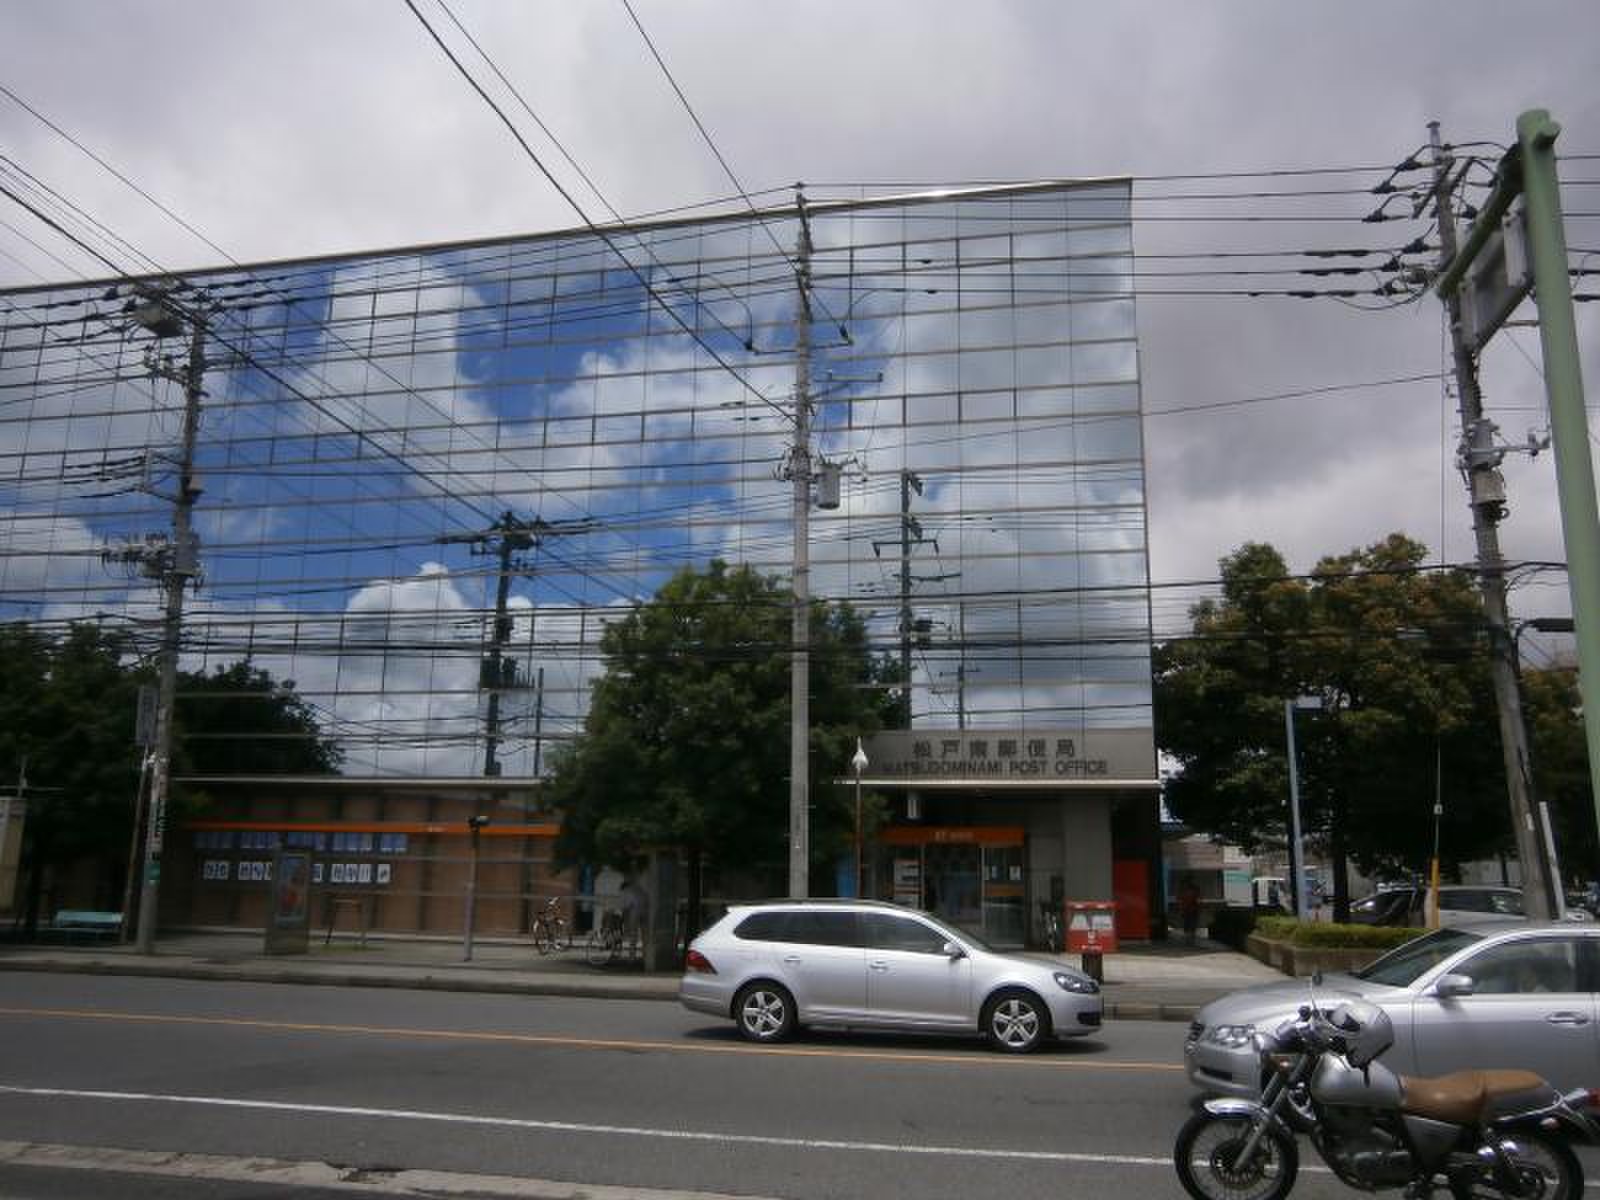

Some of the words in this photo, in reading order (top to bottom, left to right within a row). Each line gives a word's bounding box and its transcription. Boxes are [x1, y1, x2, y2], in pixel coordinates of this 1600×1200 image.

[913, 738, 1075, 758] 松戸南郵便局
[1009, 760, 1048, 774] POST
[1055, 760, 1108, 774] OFFICE
